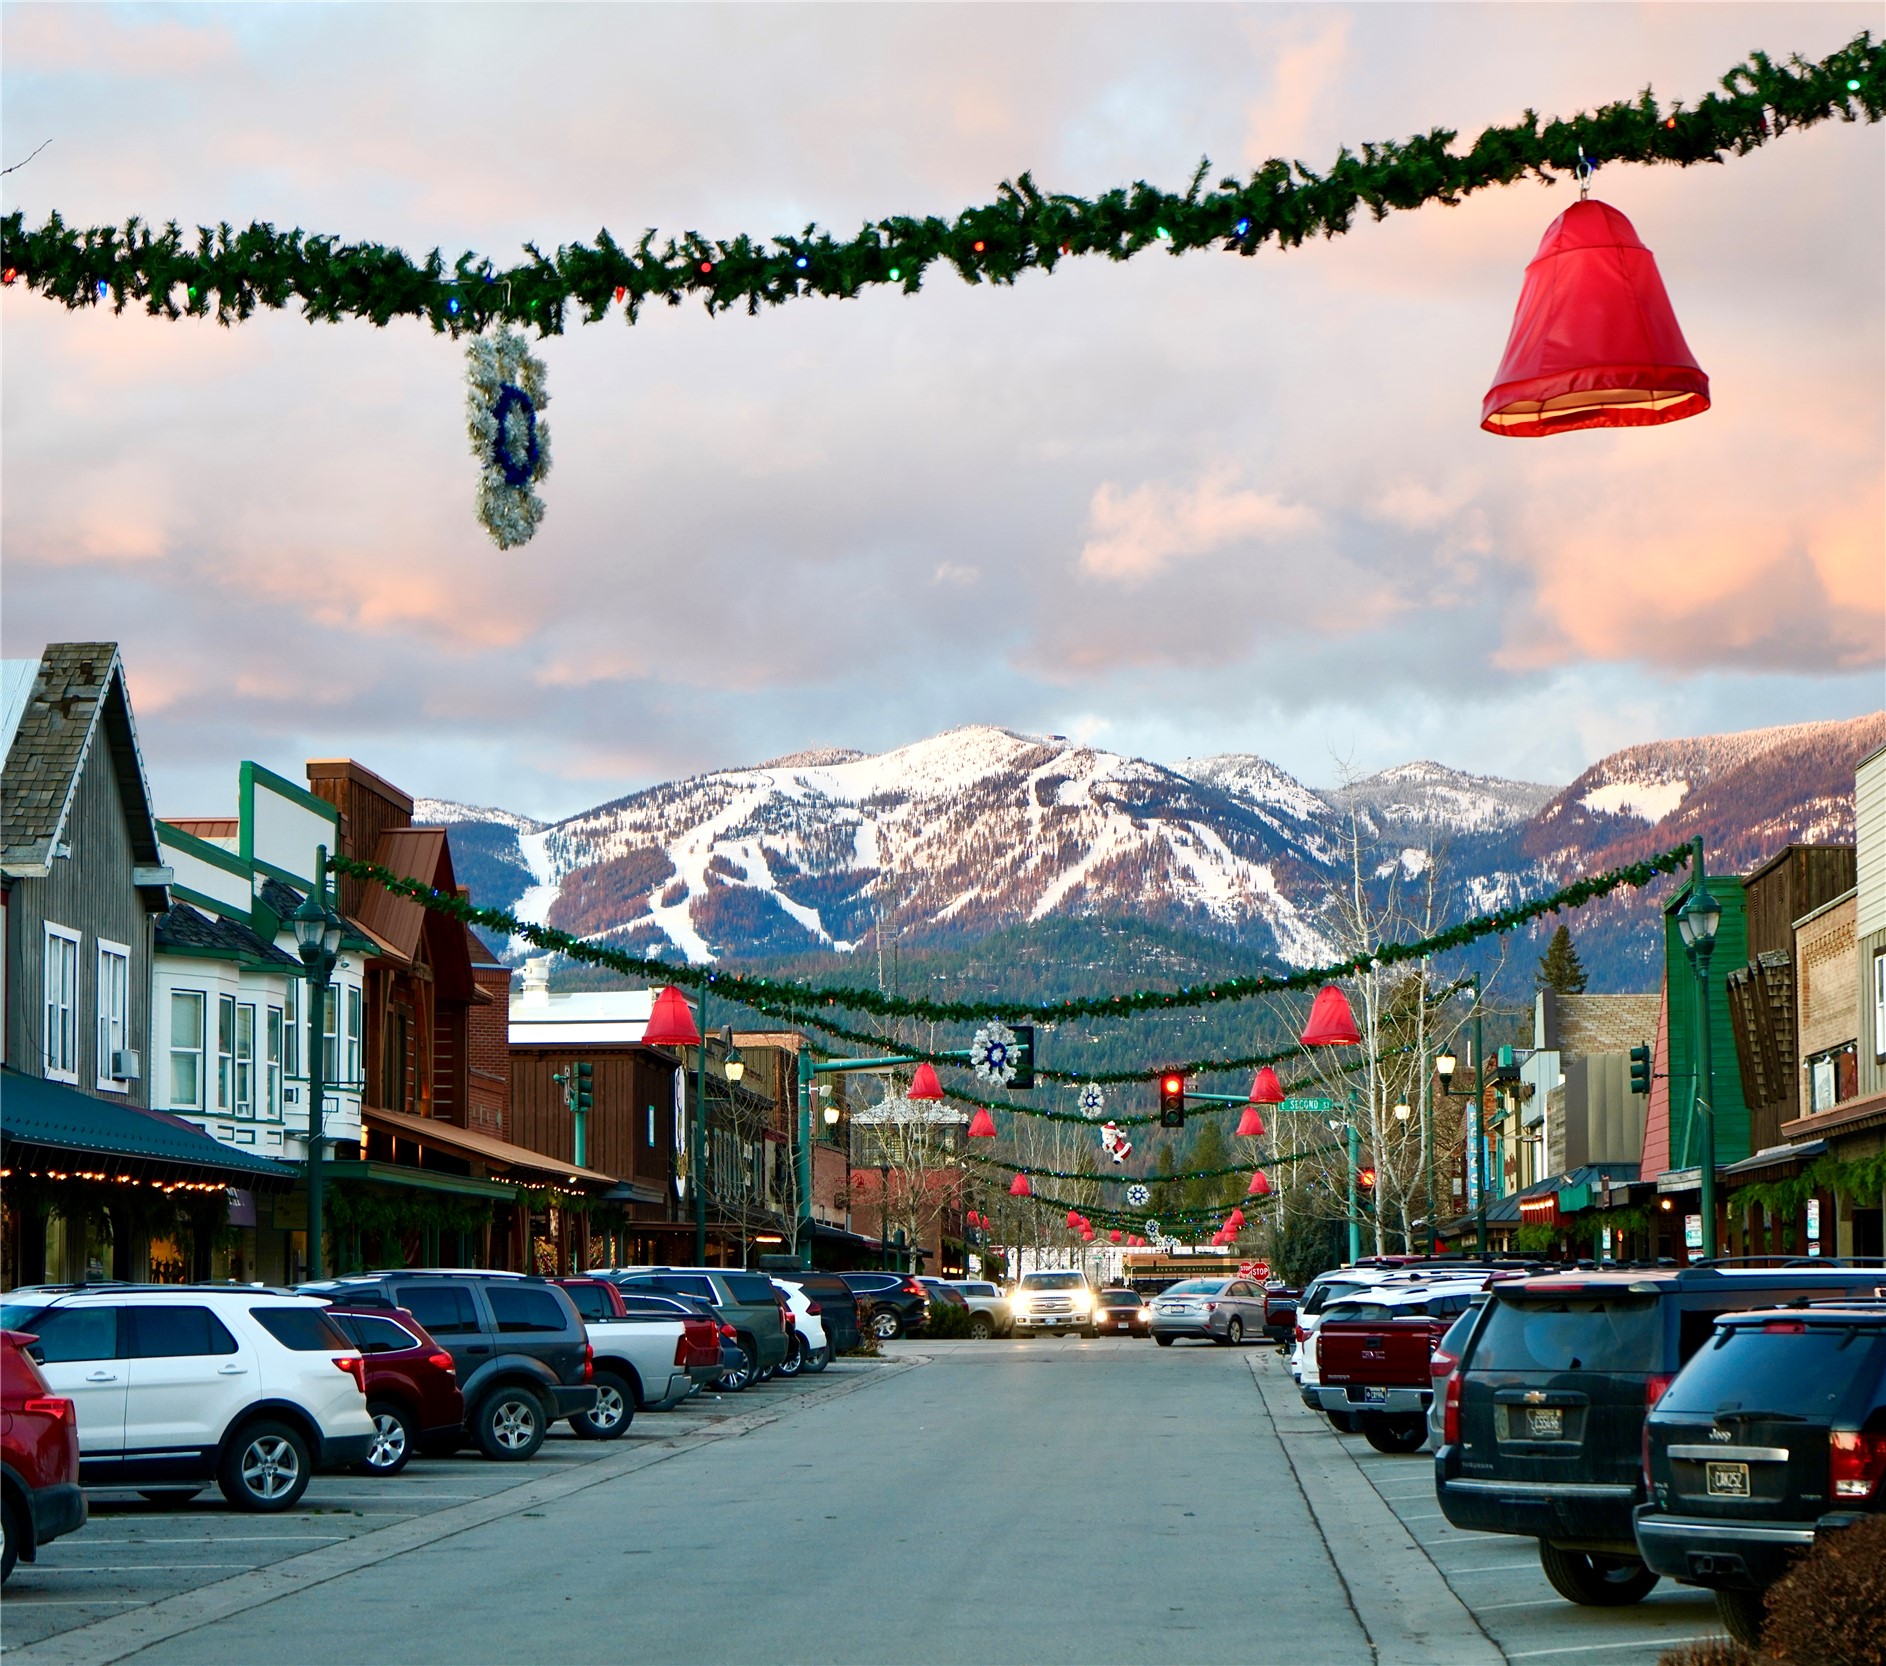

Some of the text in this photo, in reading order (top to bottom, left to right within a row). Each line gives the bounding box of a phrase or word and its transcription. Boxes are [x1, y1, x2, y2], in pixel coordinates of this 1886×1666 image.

[1290, 1100, 1319, 1109] SECOND
[1252, 1267, 1268, 1275] STOP
[1708, 1427, 1732, 1443] Jeep
